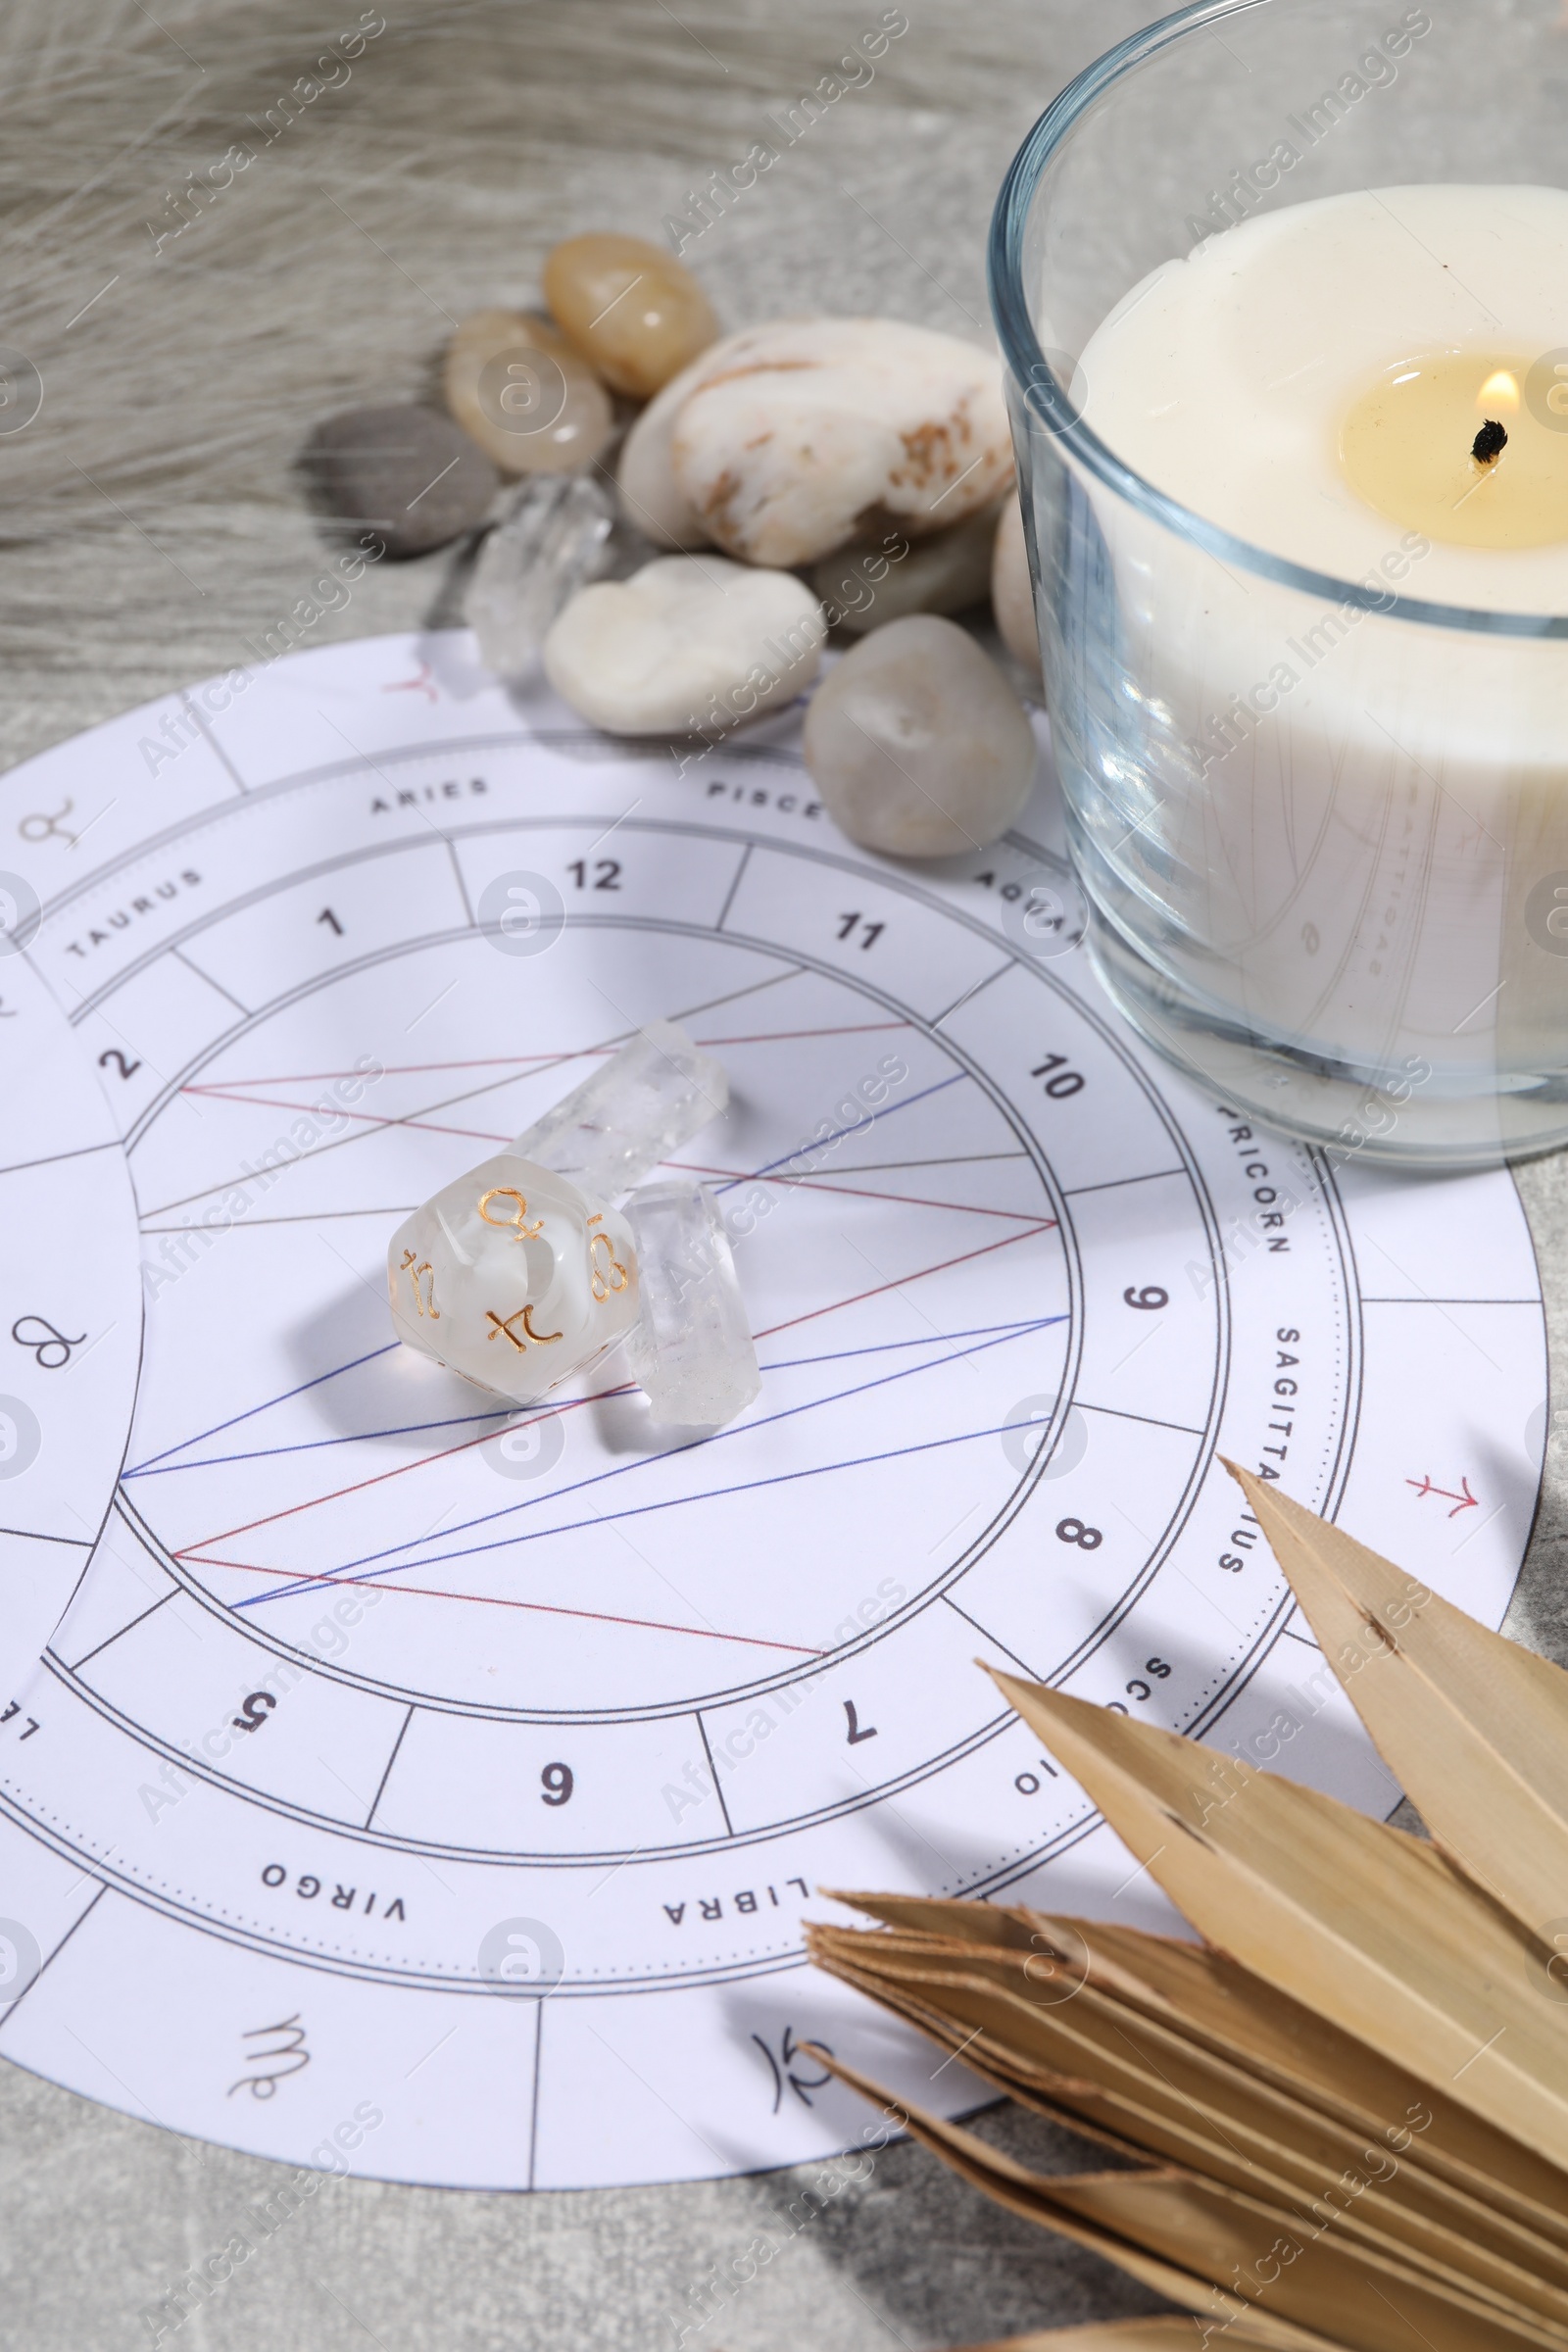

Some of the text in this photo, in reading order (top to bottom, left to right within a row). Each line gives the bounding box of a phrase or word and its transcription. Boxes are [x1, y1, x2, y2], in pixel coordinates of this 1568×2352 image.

[370, 776, 488, 816] ARIES
[707, 781, 823, 821] PISCE
[567, 859, 622, 892] 12
[65, 869, 202, 957] TAURUS
[318, 907, 344, 937] 1
[974, 870, 1085, 949] AQUAR
[836, 911, 886, 951] 11
[98, 1049, 142, 1080] 2
[1030, 1054, 1086, 1100] 10
[1123, 1286, 1169, 1310] 9
[1218, 1327, 1301, 1574] SAGITTAIUS
[1054, 1517, 1103, 1550] 8
[0, 1700, 40, 1741] LE
[232, 1690, 277, 1733] 5
[843, 1699, 878, 1745] 7
[540, 1762, 574, 1807] 6
[261, 1864, 406, 1922] VIRGO
[662, 1878, 809, 1925] LIBRA
